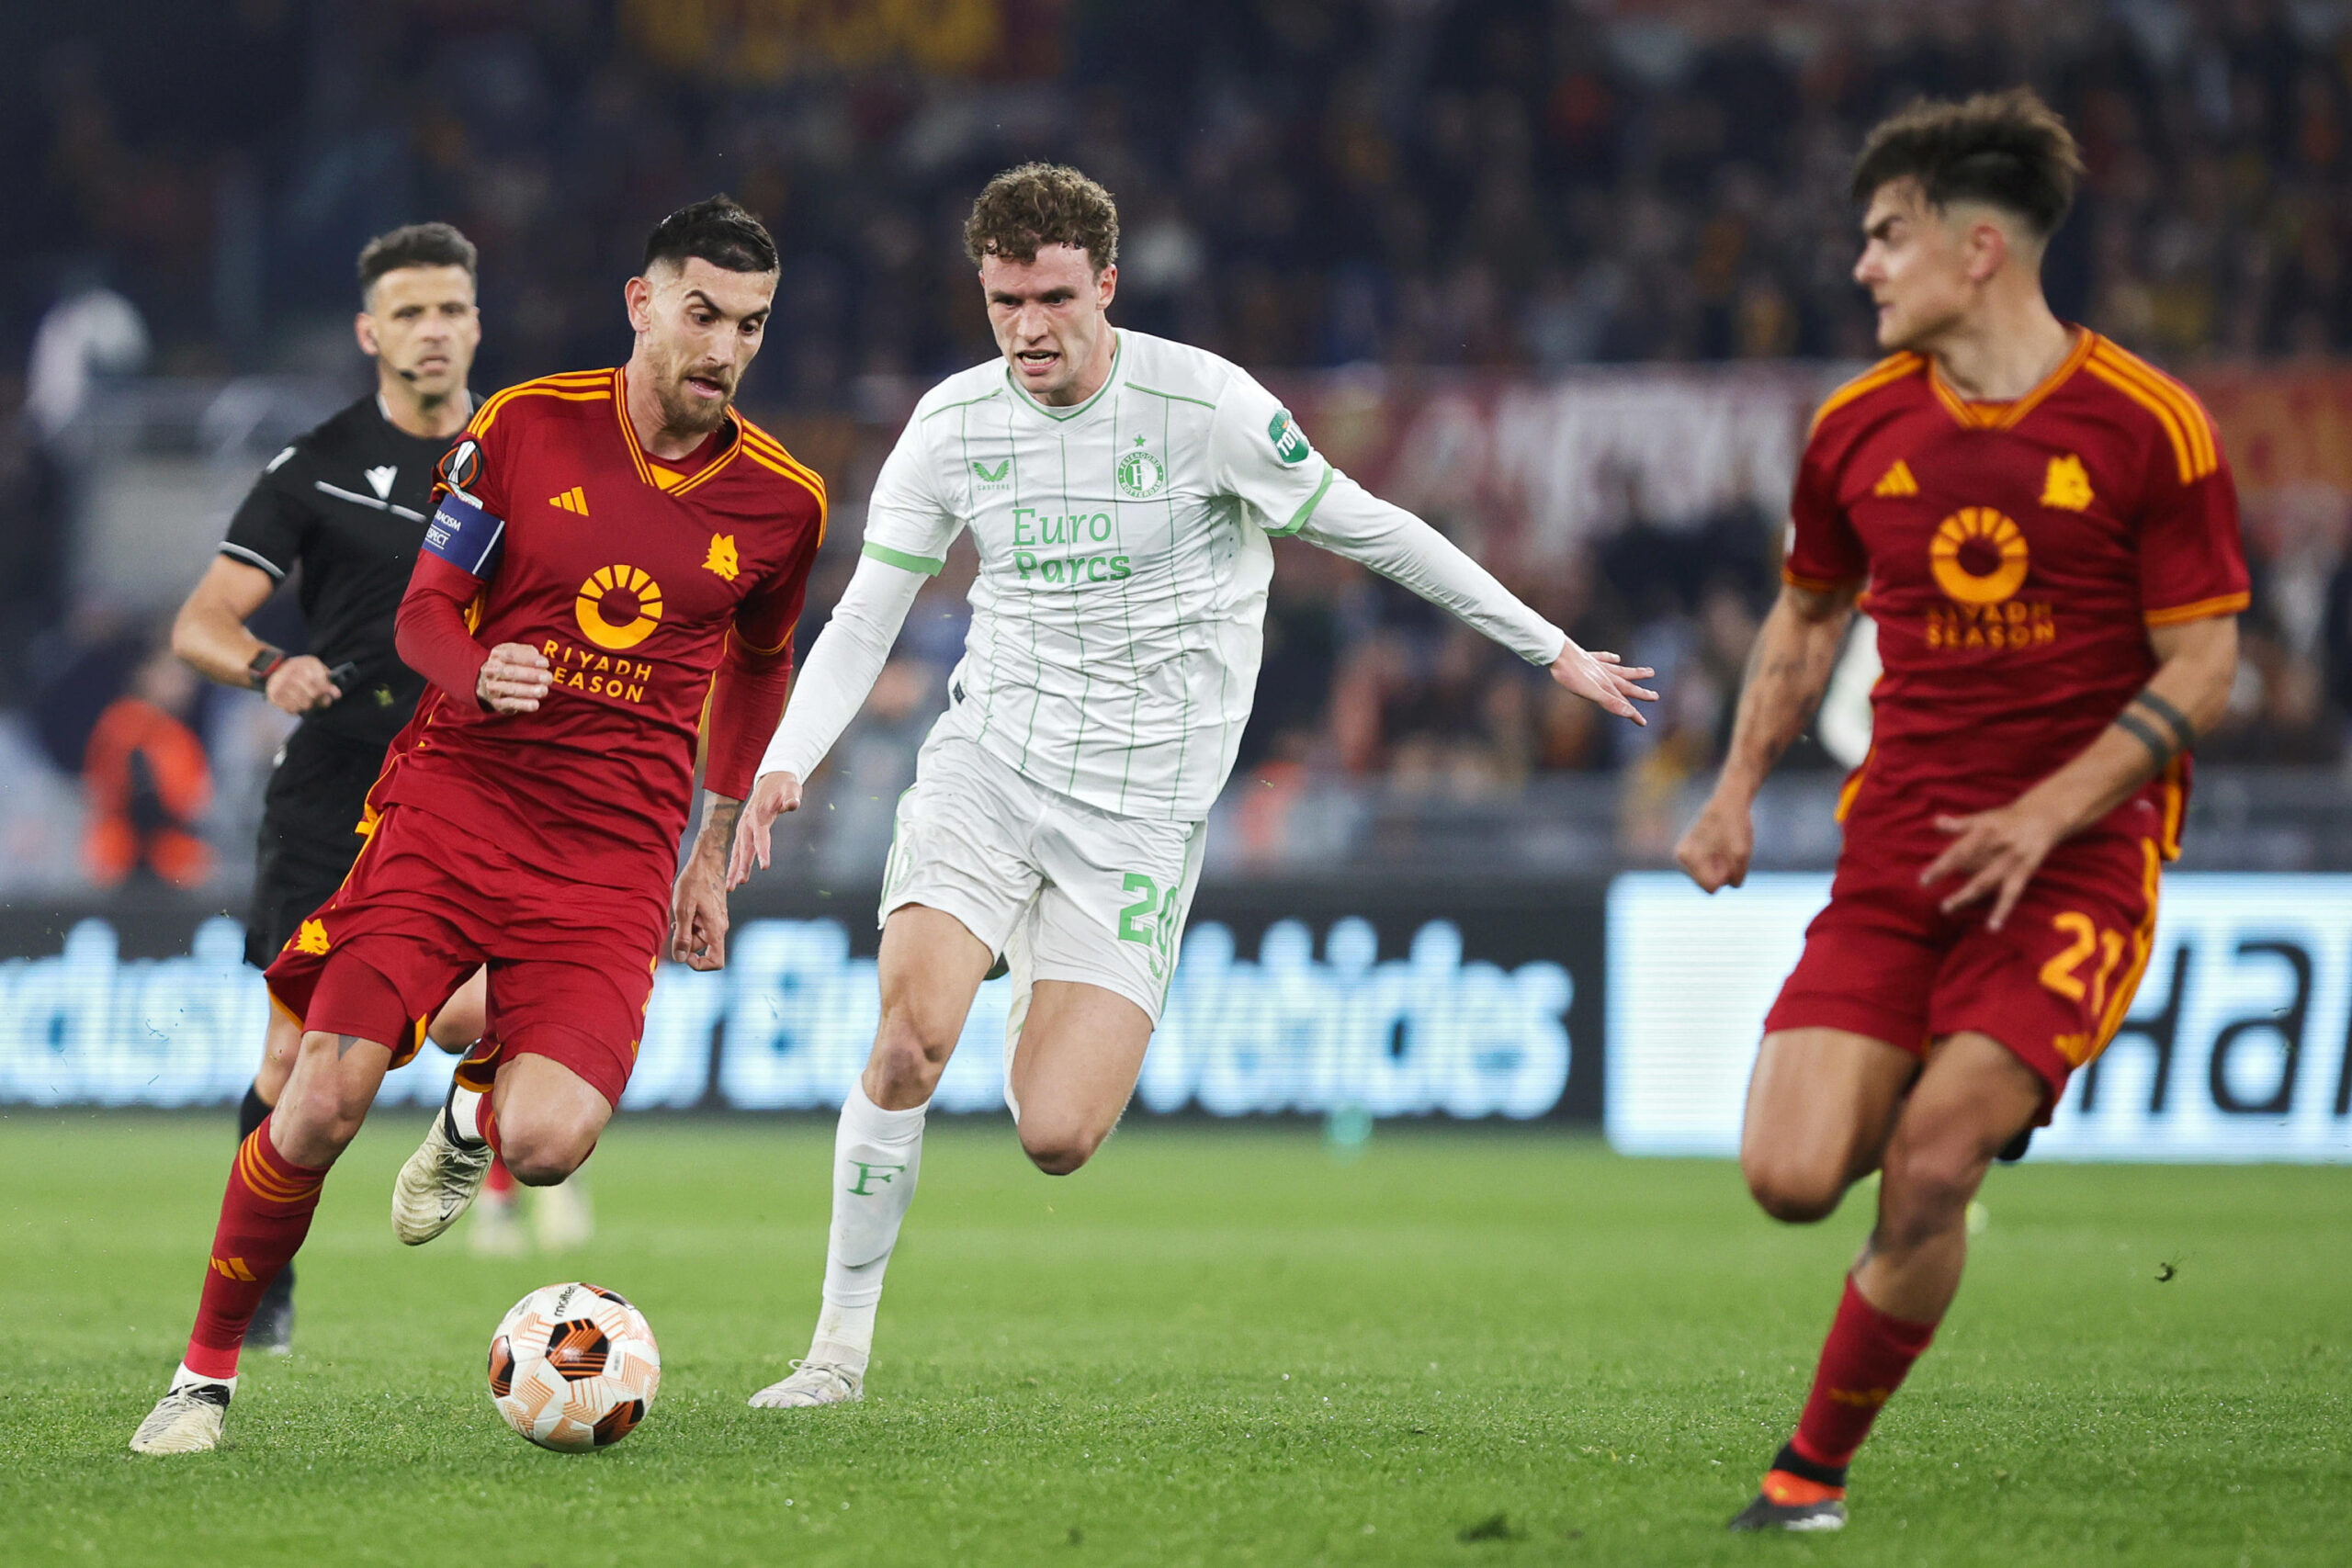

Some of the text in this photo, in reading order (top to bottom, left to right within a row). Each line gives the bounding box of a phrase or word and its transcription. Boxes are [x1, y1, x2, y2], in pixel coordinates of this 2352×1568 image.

[1012, 508, 1112, 547] Euro
[1013, 551, 1132, 583] Parcs
[1927, 622, 2055, 649] SEASON
[543, 639, 652, 682] RIYADH
[553, 667, 644, 703] EASON
[1118, 872, 1178, 957] 20
[2038, 910, 2126, 1017] 21
[2080, 939, 2352, 1114] Ha
[847, 1159, 905, 1196] F
